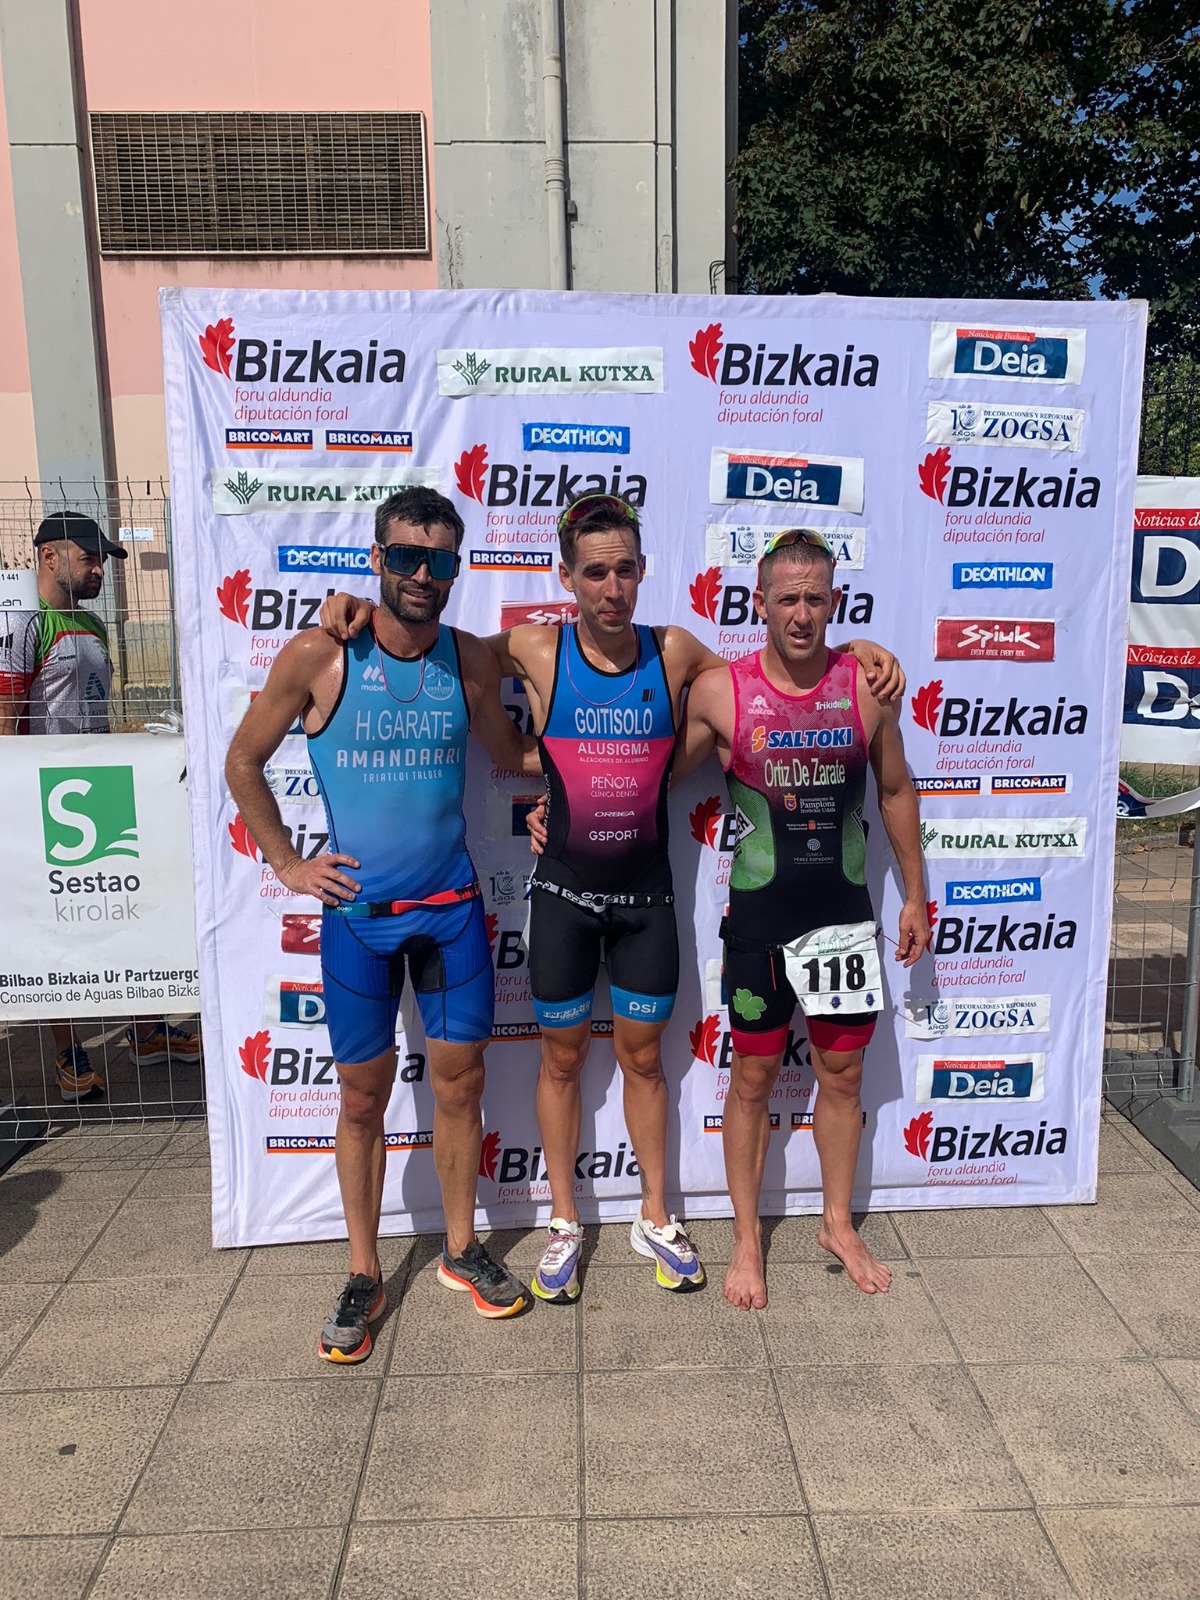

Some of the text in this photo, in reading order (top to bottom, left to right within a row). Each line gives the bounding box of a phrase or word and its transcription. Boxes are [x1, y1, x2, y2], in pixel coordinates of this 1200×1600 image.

[235, 339, 406, 383] Bizkaia
[720, 343, 880, 386] Bizkaia
[974, 340, 1047, 375] Deia
[495, 365, 655, 383] RURAL KUTXA
[234, 387, 332, 403] foru aldundia
[719, 391, 809, 406] foru aldundia
[234, 406, 348, 422] diputación foral
[718, 409, 823, 425] diputación foral
[228, 431, 310, 443] BRICOMART
[531, 427, 622, 446] DECATHLON
[982, 417, 1071, 442] ZOGSA
[328, 432, 409, 445] BRICOMART
[745, 466, 820, 501] Deia
[947, 466, 1101, 508] Bizkaia
[267, 485, 415, 501] RURAL KUT
[487, 511, 514, 527] foru
[945, 512, 1031, 526] foru aldundia
[1134, 511, 1185, 528] Noticias
[485, 529, 557, 545] diputación
[943, 529, 1045, 544] diputación foral
[472, 552, 550, 565] BRICOMART
[961, 567, 1045, 582] DECATHLON
[251, 635, 279, 649] foru
[719, 630, 745, 645] foru
[957, 624, 1040, 650] Spiuk
[1180, 650, 1195, 665] de
[574, 707, 653, 735] GOITISOLO
[939, 697, 1088, 737] Bizkaia
[355, 710, 453, 741] H.GARATE
[767, 727, 853, 749] SALTOKI
[577, 742, 650, 756] ALUSIGMA
[937, 741, 1022, 755] foru aldundia
[579, 756, 614, 764] ALEACIONES
[936, 756, 1035, 772] diputación foral
[363, 769, 443, 783] TRIATLOI TALDEA
[764, 757, 846, 787] Ortiz De Zarate
[591, 773, 639, 789] PEÑOTA
[994, 777, 1064, 788] BRICOMART
[800, 801, 836, 809] Pamplona
[594, 810, 636, 818] ORBEA
[588, 828, 639, 841] GSPORT
[941, 833, 1078, 849] RURAL KUTXA
[48, 870, 140, 894] Sestao
[953, 882, 1034, 899] DECATHLON
[54, 895, 140, 922] kirolak
[934, 913, 1077, 955] Bizkaia
[932, 956, 1014, 973] foru aldundia
[0, 973, 44, 988] Bilbao
[48, 971, 100, 985] Bizkaia
[104, 970, 121, 983] Ur
[495, 973, 521, 987] foru
[802, 953, 866, 993] 118
[931, 971, 1026, 989] diputación foral
[0, 990, 62, 1004] Consorcio
[65, 990, 81, 1002] de
[84, 989, 123, 1003] Aguas
[127, 985, 164, 999] Bilbao
[629, 1001, 657, 1014] psi
[955, 1009, 1035, 1029] ZOGSA
[948, 1071, 1015, 1097] Deia
[269, 1089, 297, 1102] foru
[786, 1086, 814, 1099] foral
[269, 1105, 339, 1119] diputación
[930, 1121, 1067, 1163] Bizkaia
[927, 1161, 1006, 1177] foru aldundia
[991, 1173, 1018, 1185] foral
[498, 1186, 525, 1198] foru
